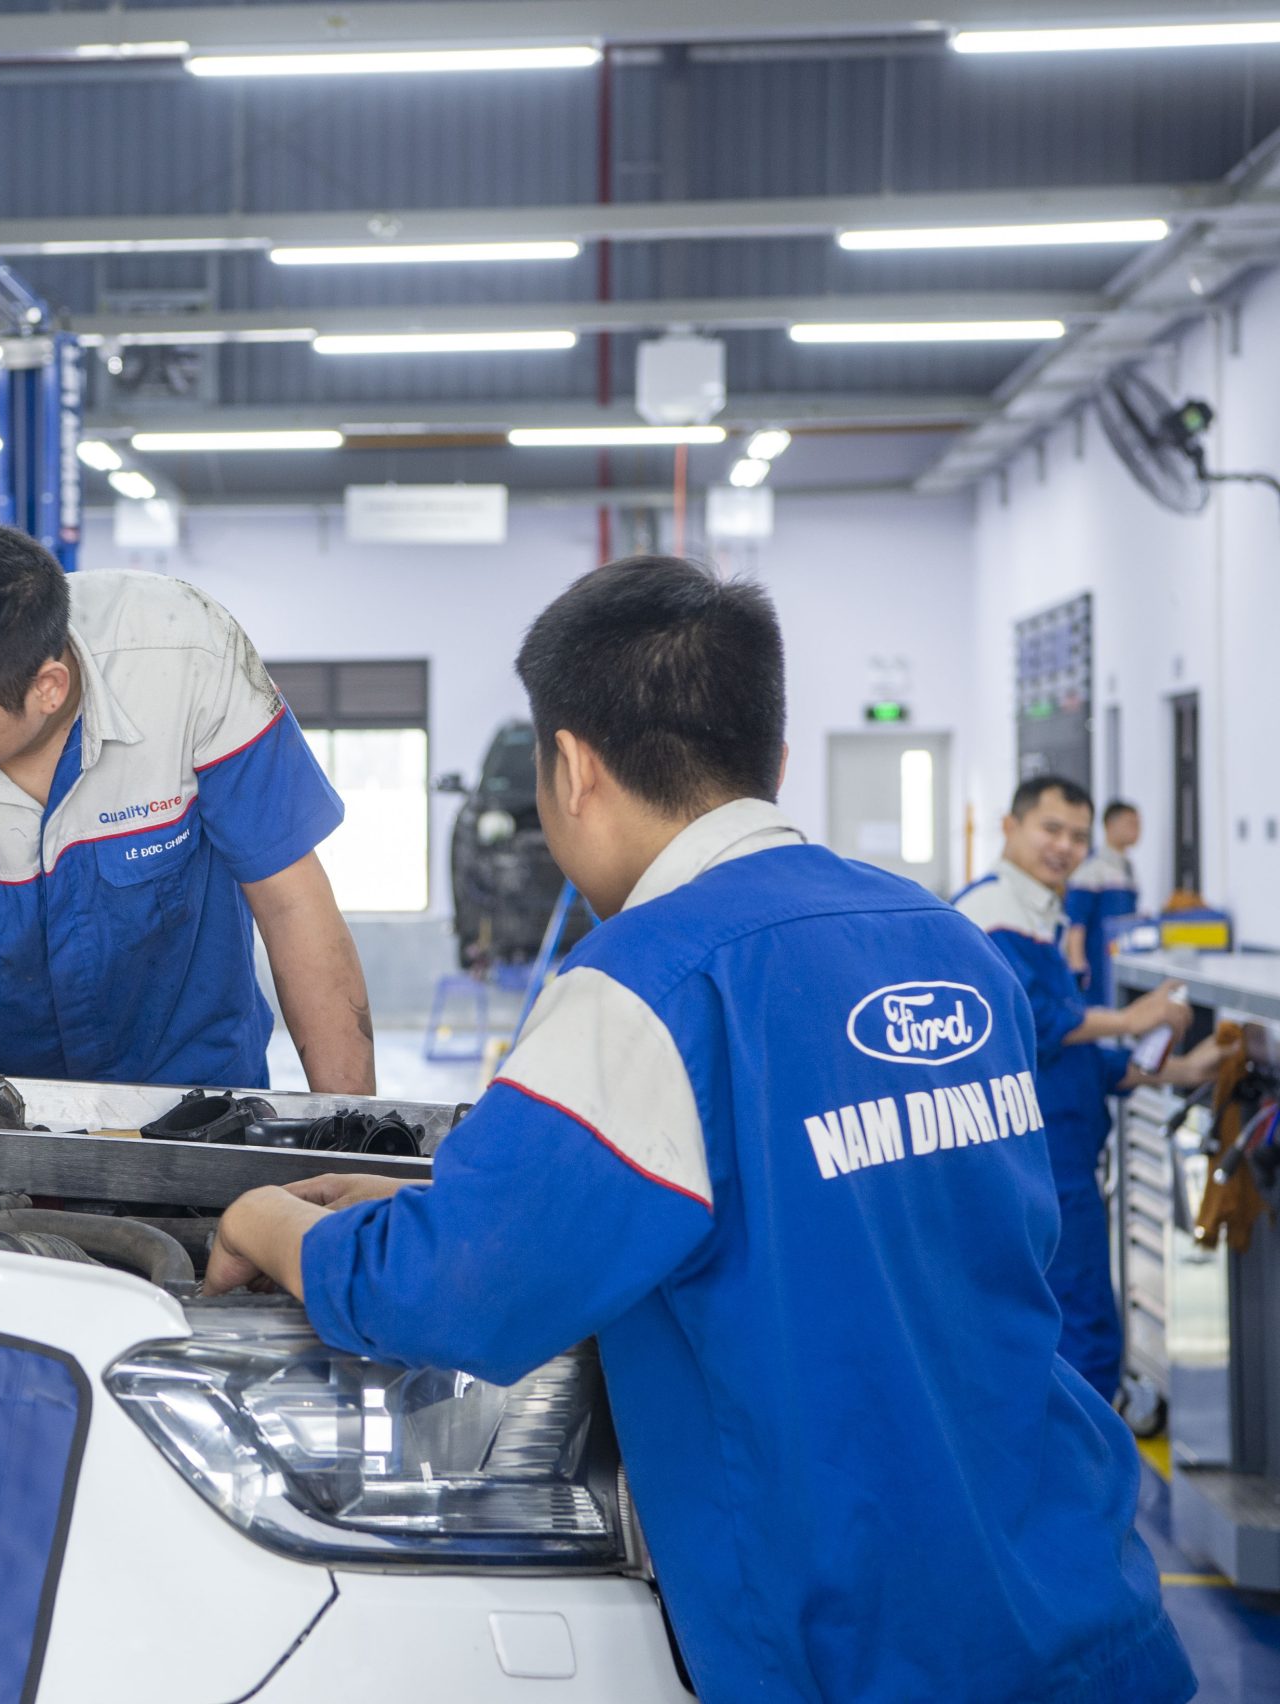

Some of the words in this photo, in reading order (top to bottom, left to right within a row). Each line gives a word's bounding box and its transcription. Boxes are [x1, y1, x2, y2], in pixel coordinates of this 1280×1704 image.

[99, 796, 182, 823] QualityCare
[125, 847, 139, 860] LÊ
[883, 993, 973, 1053] Ford
[803, 1097, 905, 1179] NAM
